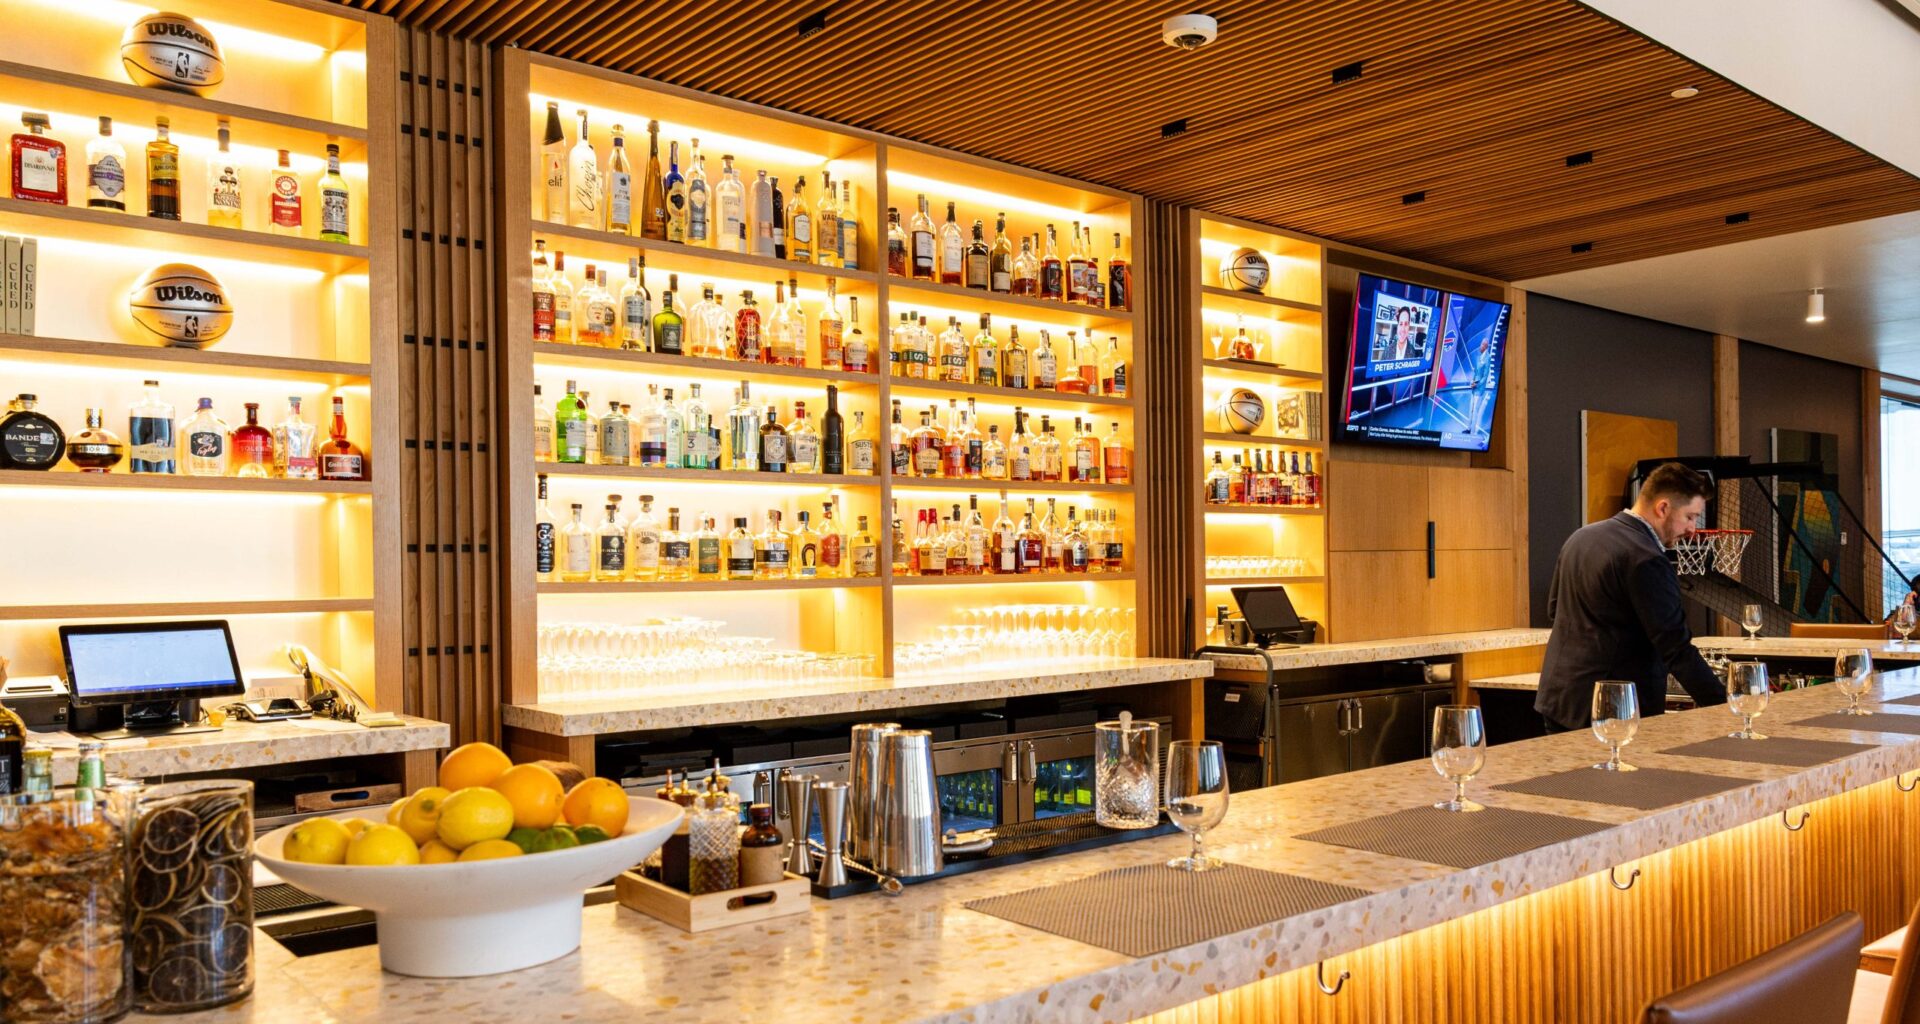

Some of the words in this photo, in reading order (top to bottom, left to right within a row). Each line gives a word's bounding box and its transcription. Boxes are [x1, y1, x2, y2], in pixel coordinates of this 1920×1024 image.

[145, 22, 215, 51] Wilson
[548, 175, 563, 188] elit
[9, 262, 18, 309] CURED
[25, 264, 34, 310] CURED
[154, 285, 223, 305] Wilson
[1374, 362, 1394, 372] PETER
[1395, 360, 1421, 370] SCHRAGER
[1346, 424, 1359, 432] ESPN
